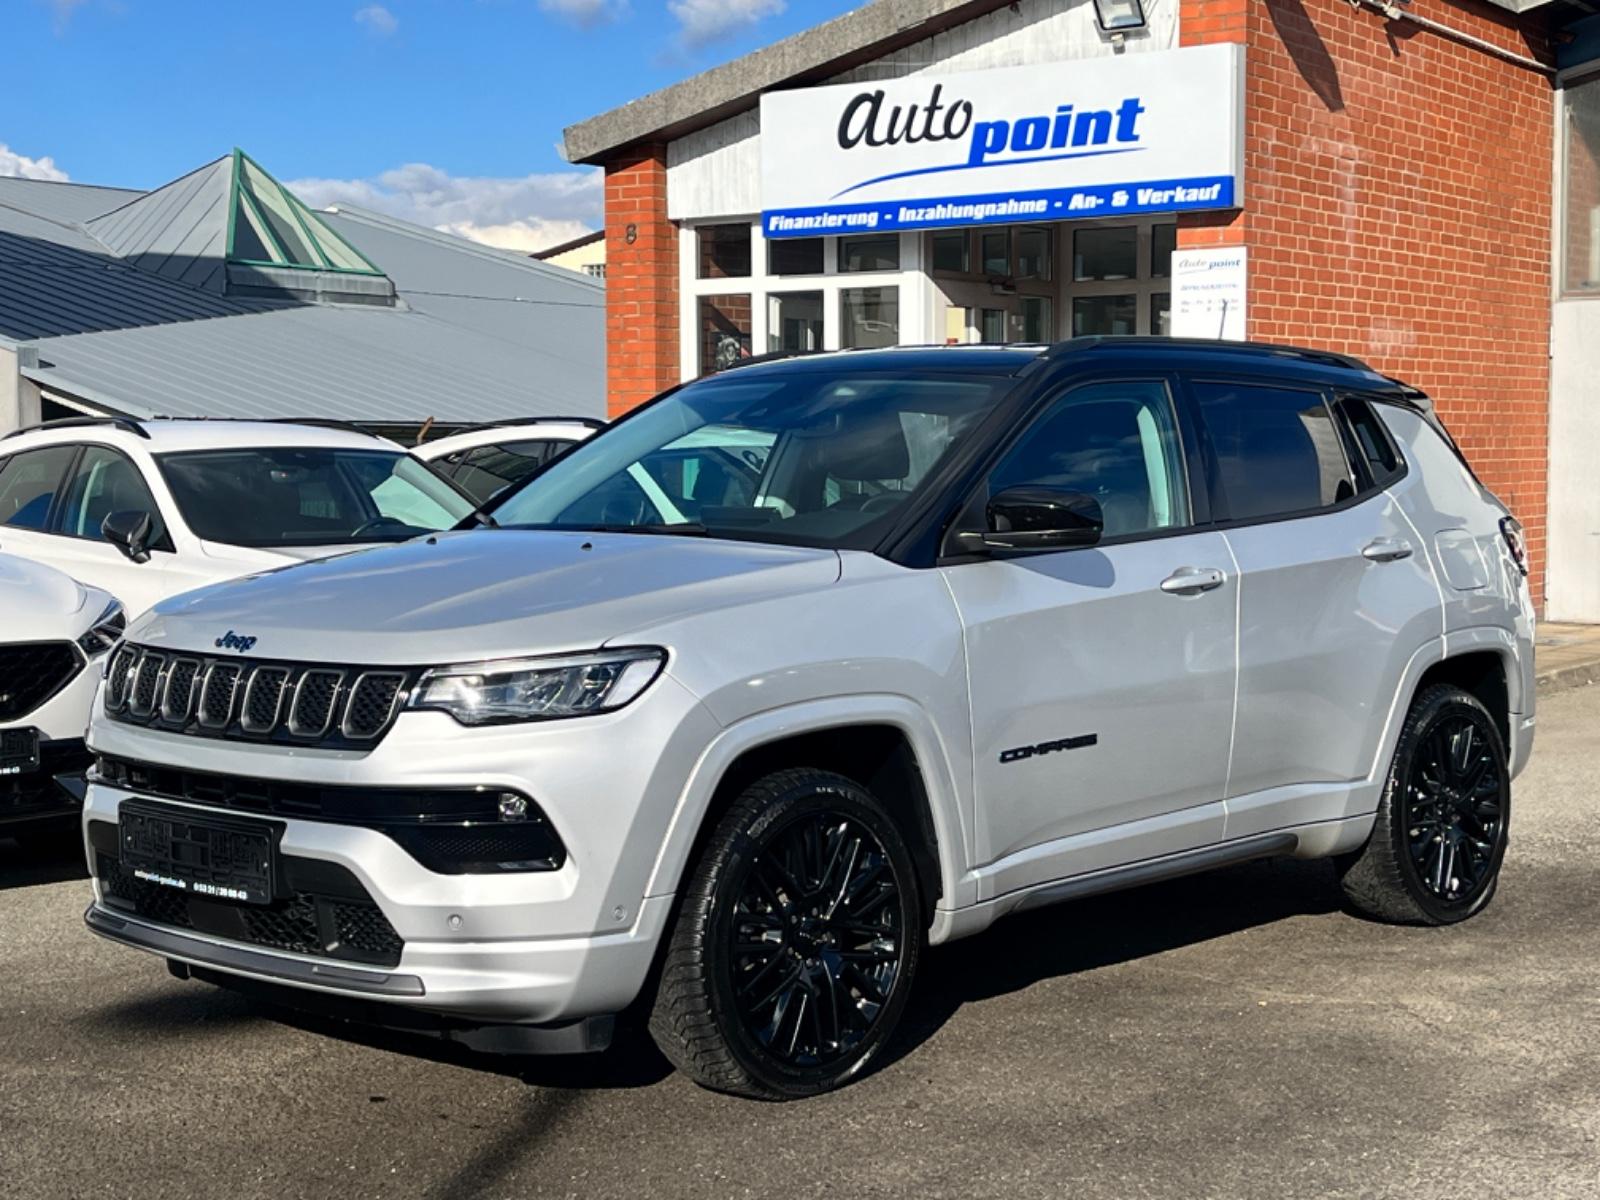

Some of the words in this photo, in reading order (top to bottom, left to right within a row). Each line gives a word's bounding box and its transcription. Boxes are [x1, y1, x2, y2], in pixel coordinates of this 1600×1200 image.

[968, 98, 1145, 166] point
[769, 211, 879, 231] Finanzierung
[898, 198, 1047, 222] Inzahlungnahme
[1068, 193, 1104, 210] An-
[1111, 190, 1129, 207] &
[1137, 183, 1221, 205] Verkauf
[625, 223, 637, 245] 8
[1208, 259, 1241, 271] point
[214, 630, 257, 653] Jeep
